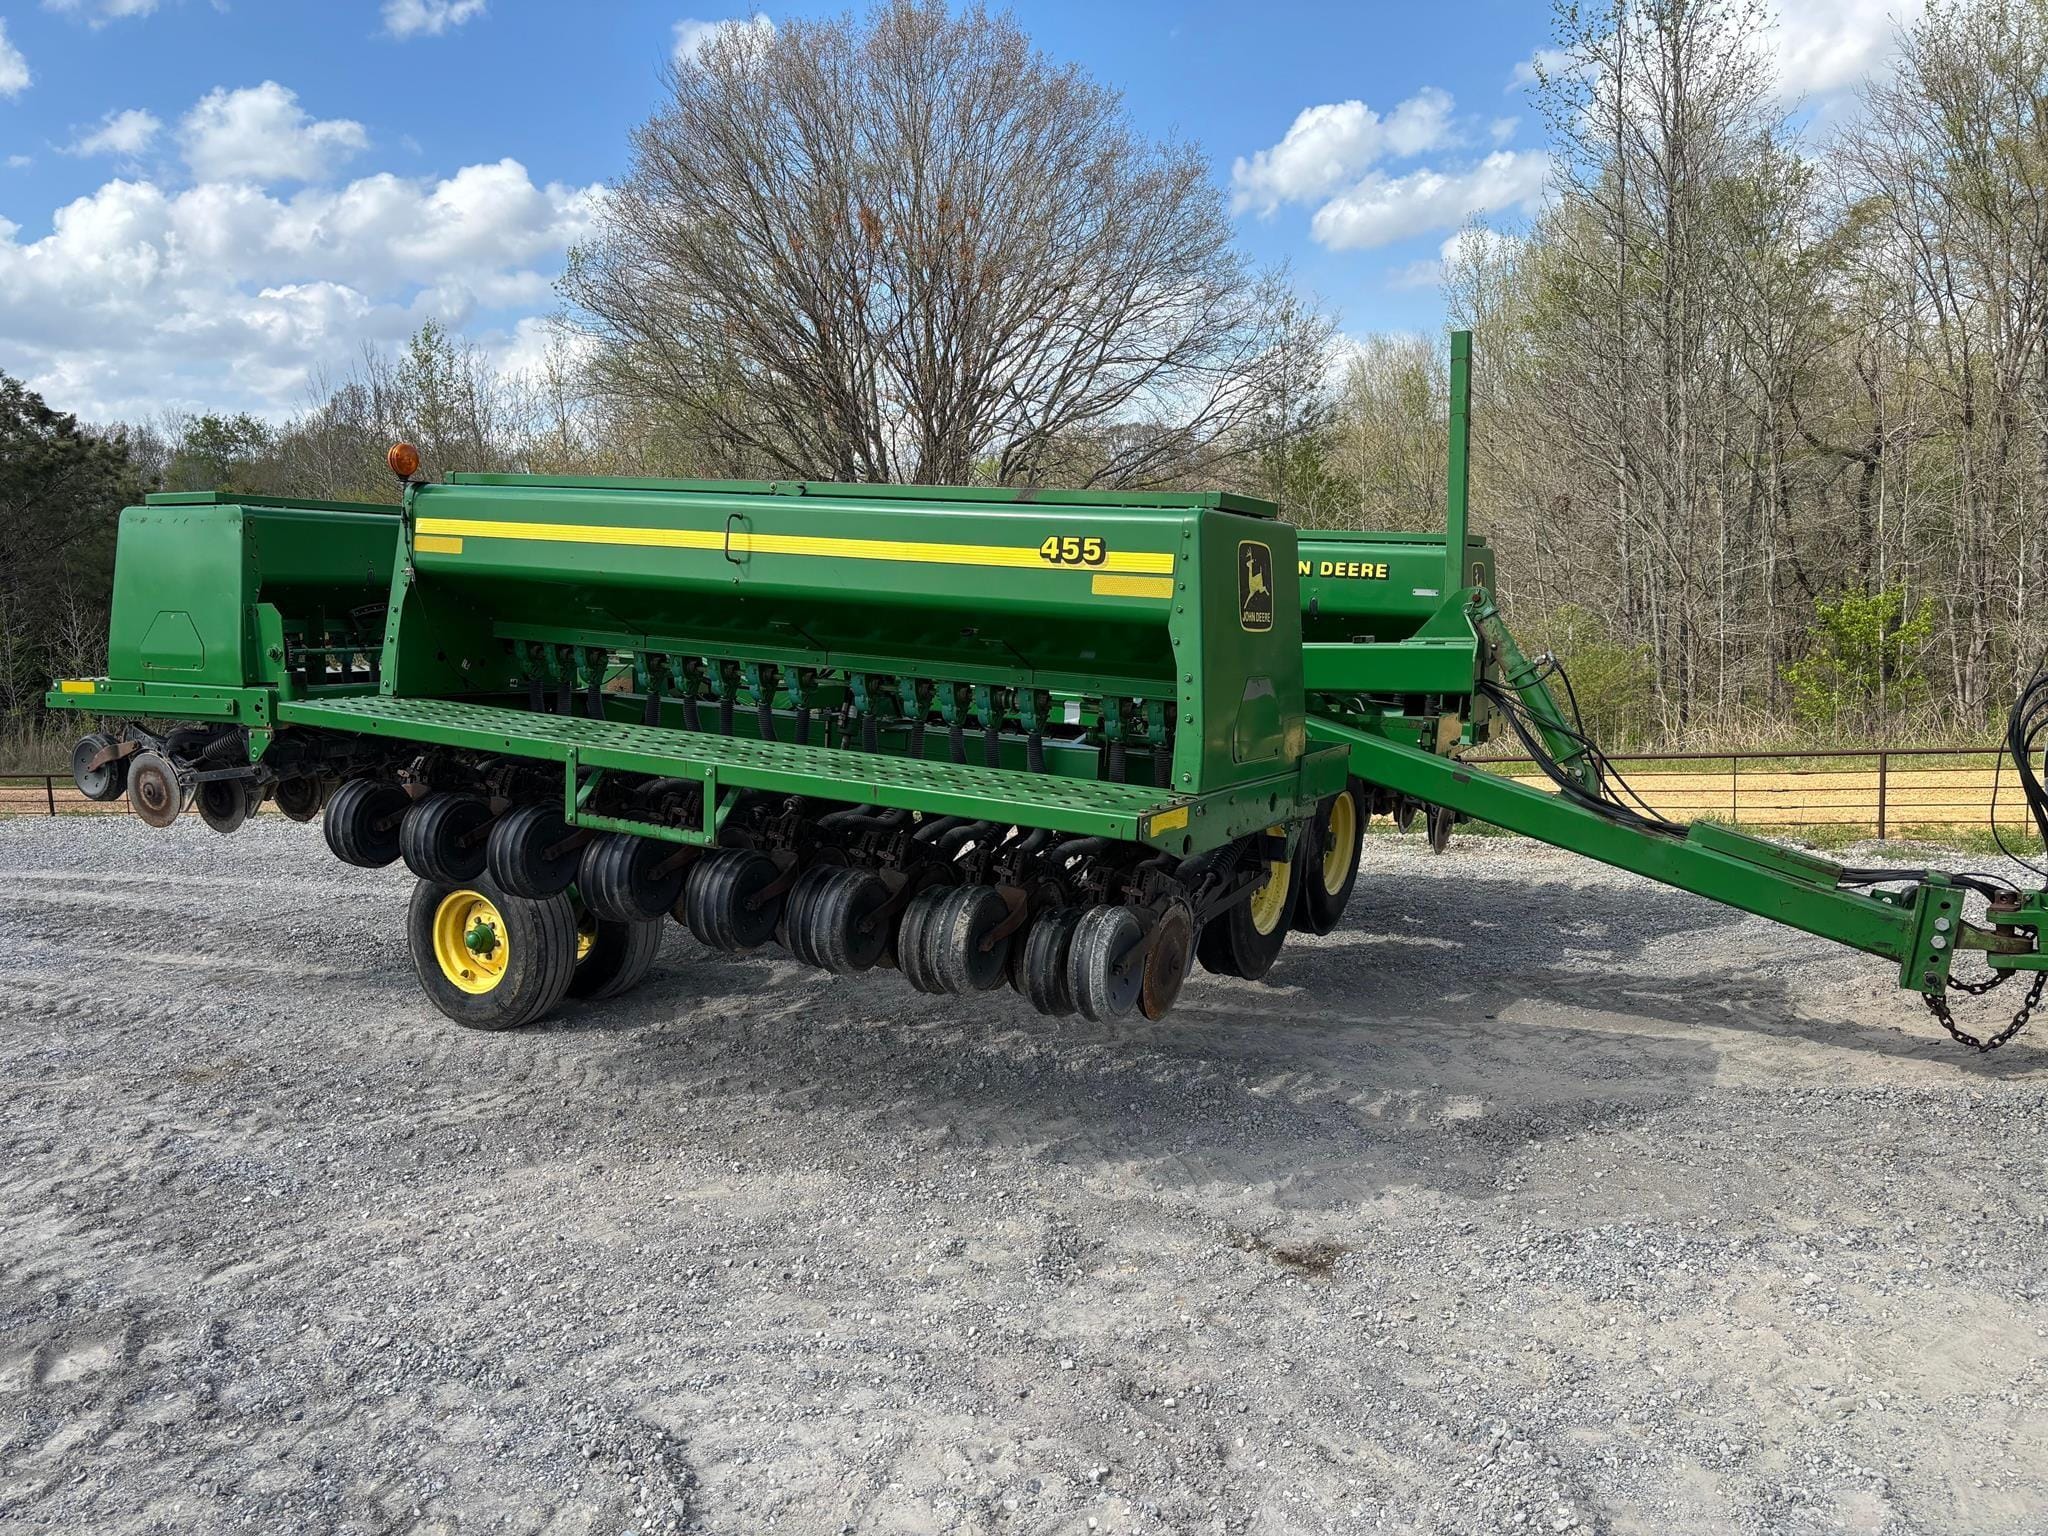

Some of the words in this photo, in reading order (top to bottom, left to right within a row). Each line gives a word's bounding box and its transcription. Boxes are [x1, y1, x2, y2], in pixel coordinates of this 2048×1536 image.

[1040, 536, 1106, 565] 455
[1320, 561, 1390, 581] DEERE
[1242, 611, 1255, 623] JOHN
[1256, 612, 1271, 623] DEERE
